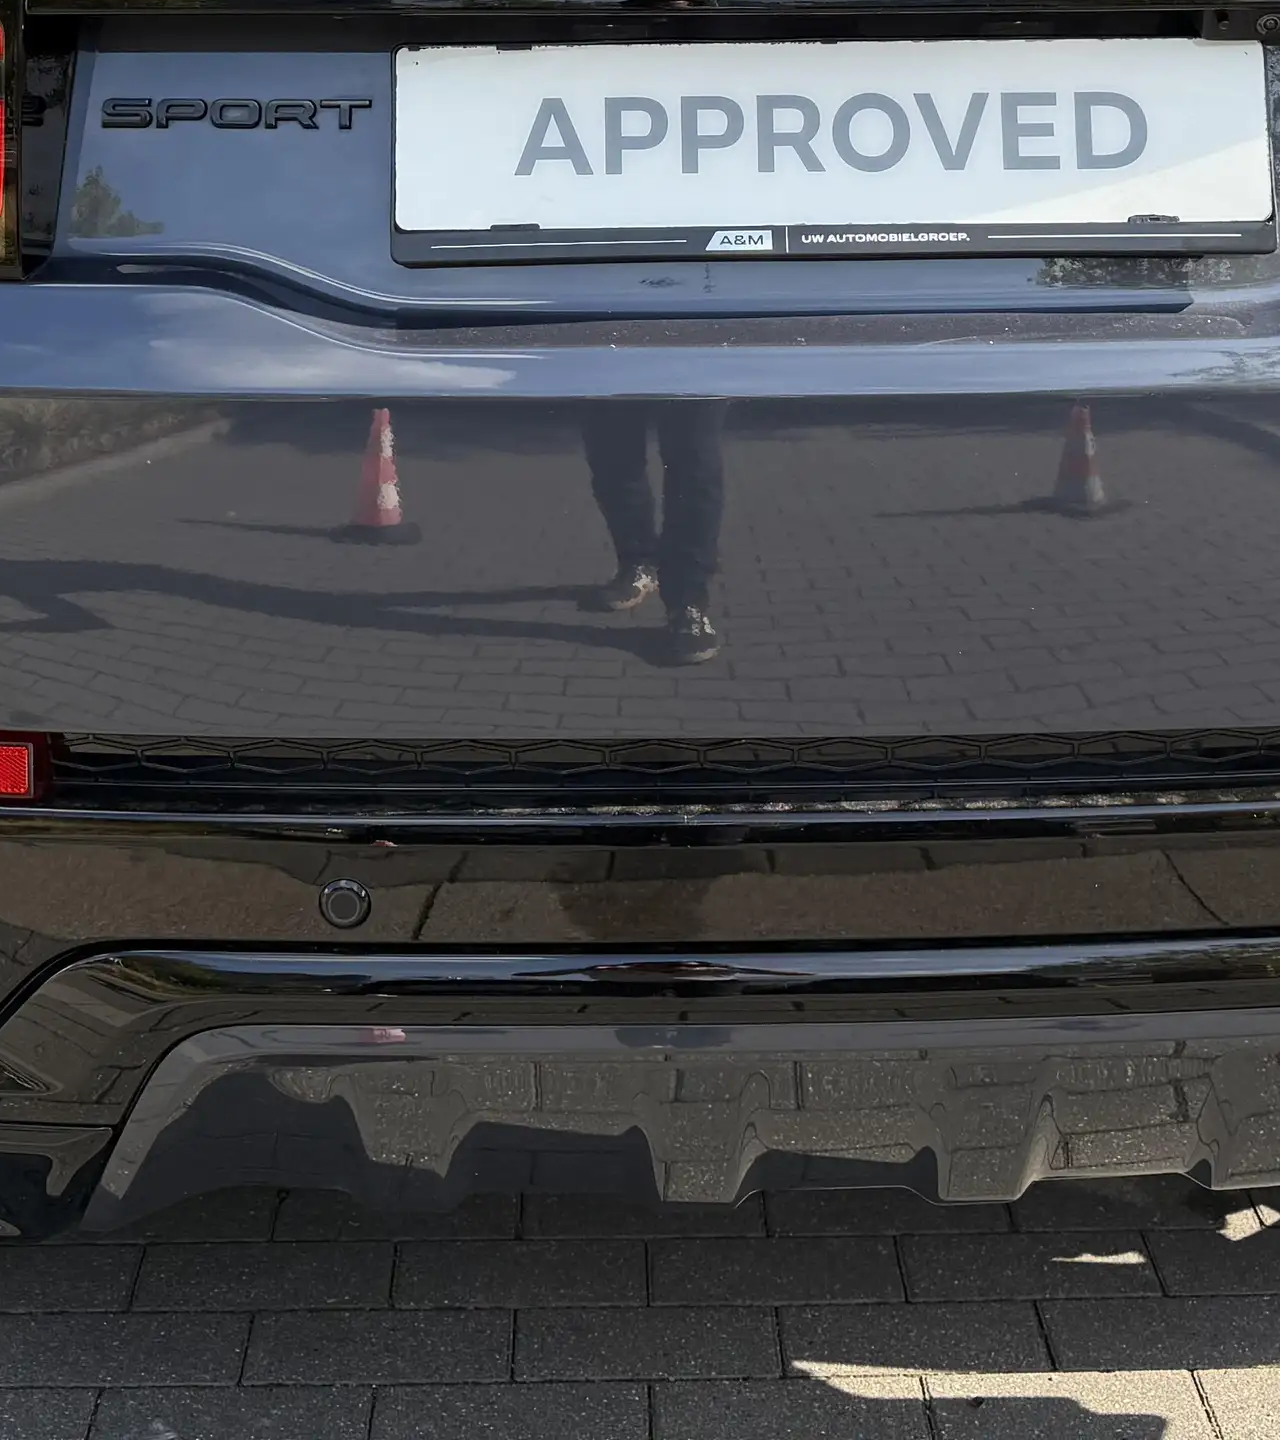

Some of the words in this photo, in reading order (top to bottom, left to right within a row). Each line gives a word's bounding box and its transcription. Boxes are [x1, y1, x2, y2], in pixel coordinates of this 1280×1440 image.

[101, 97, 373, 130] SPORT
[513, 91, 1149, 176] APPROVED
[719, 234, 764, 246] A&M
[801, 233, 825, 244] UW
